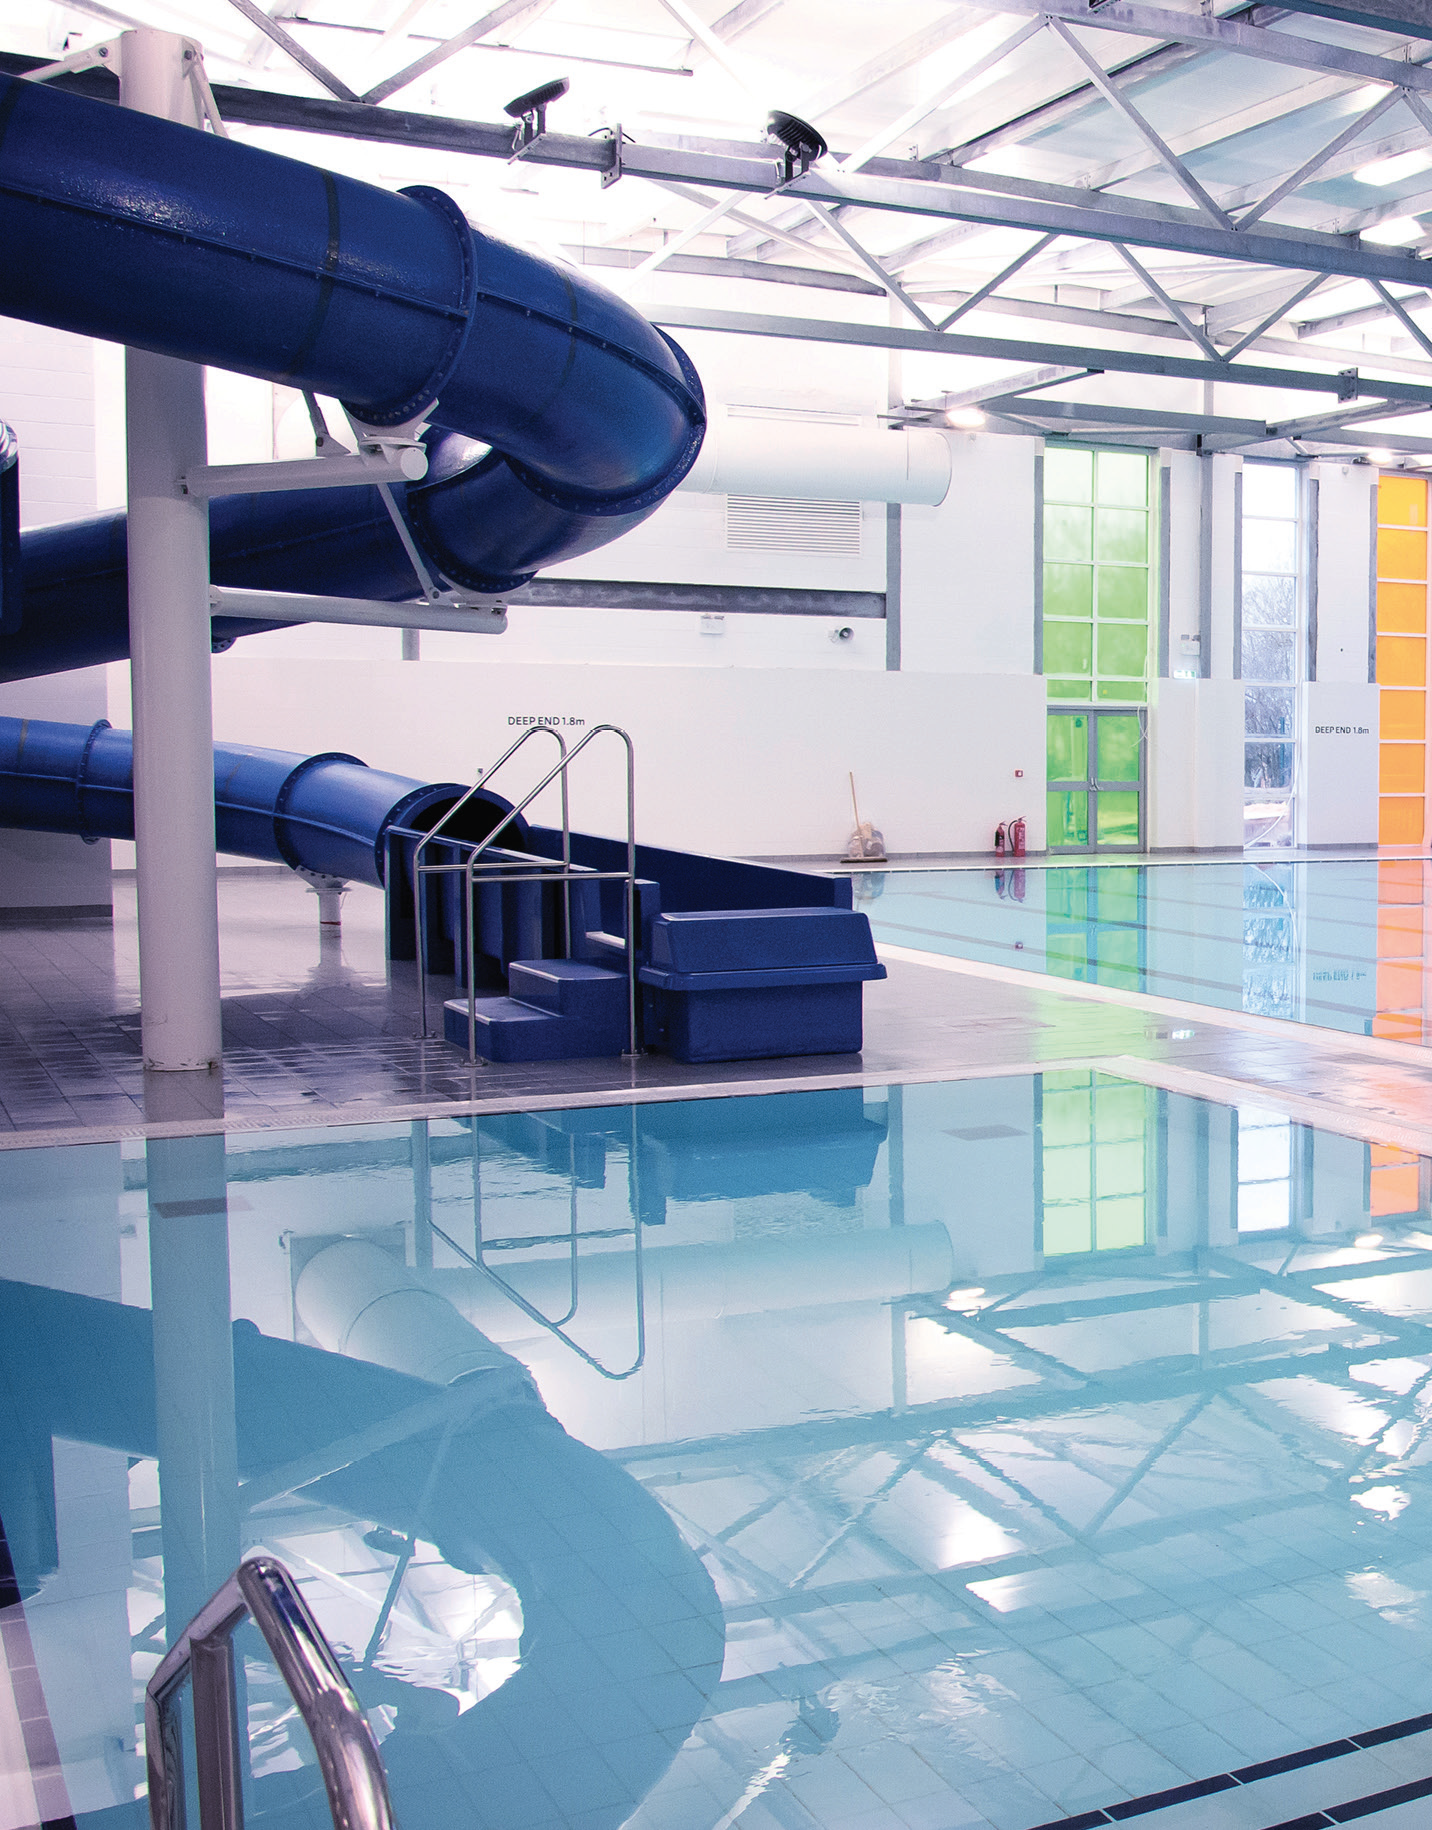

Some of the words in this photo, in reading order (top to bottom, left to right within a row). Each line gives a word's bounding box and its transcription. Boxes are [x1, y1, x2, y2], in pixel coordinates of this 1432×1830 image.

[507, 716, 536, 726] DEEP
[537, 716, 560, 726] END
[562, 716, 585, 726] 1.8m
[1315, 726, 1335, 734] DEEP
[1335, 726, 1352, 734] END
[1353, 726, 1370, 734] 1.8m
